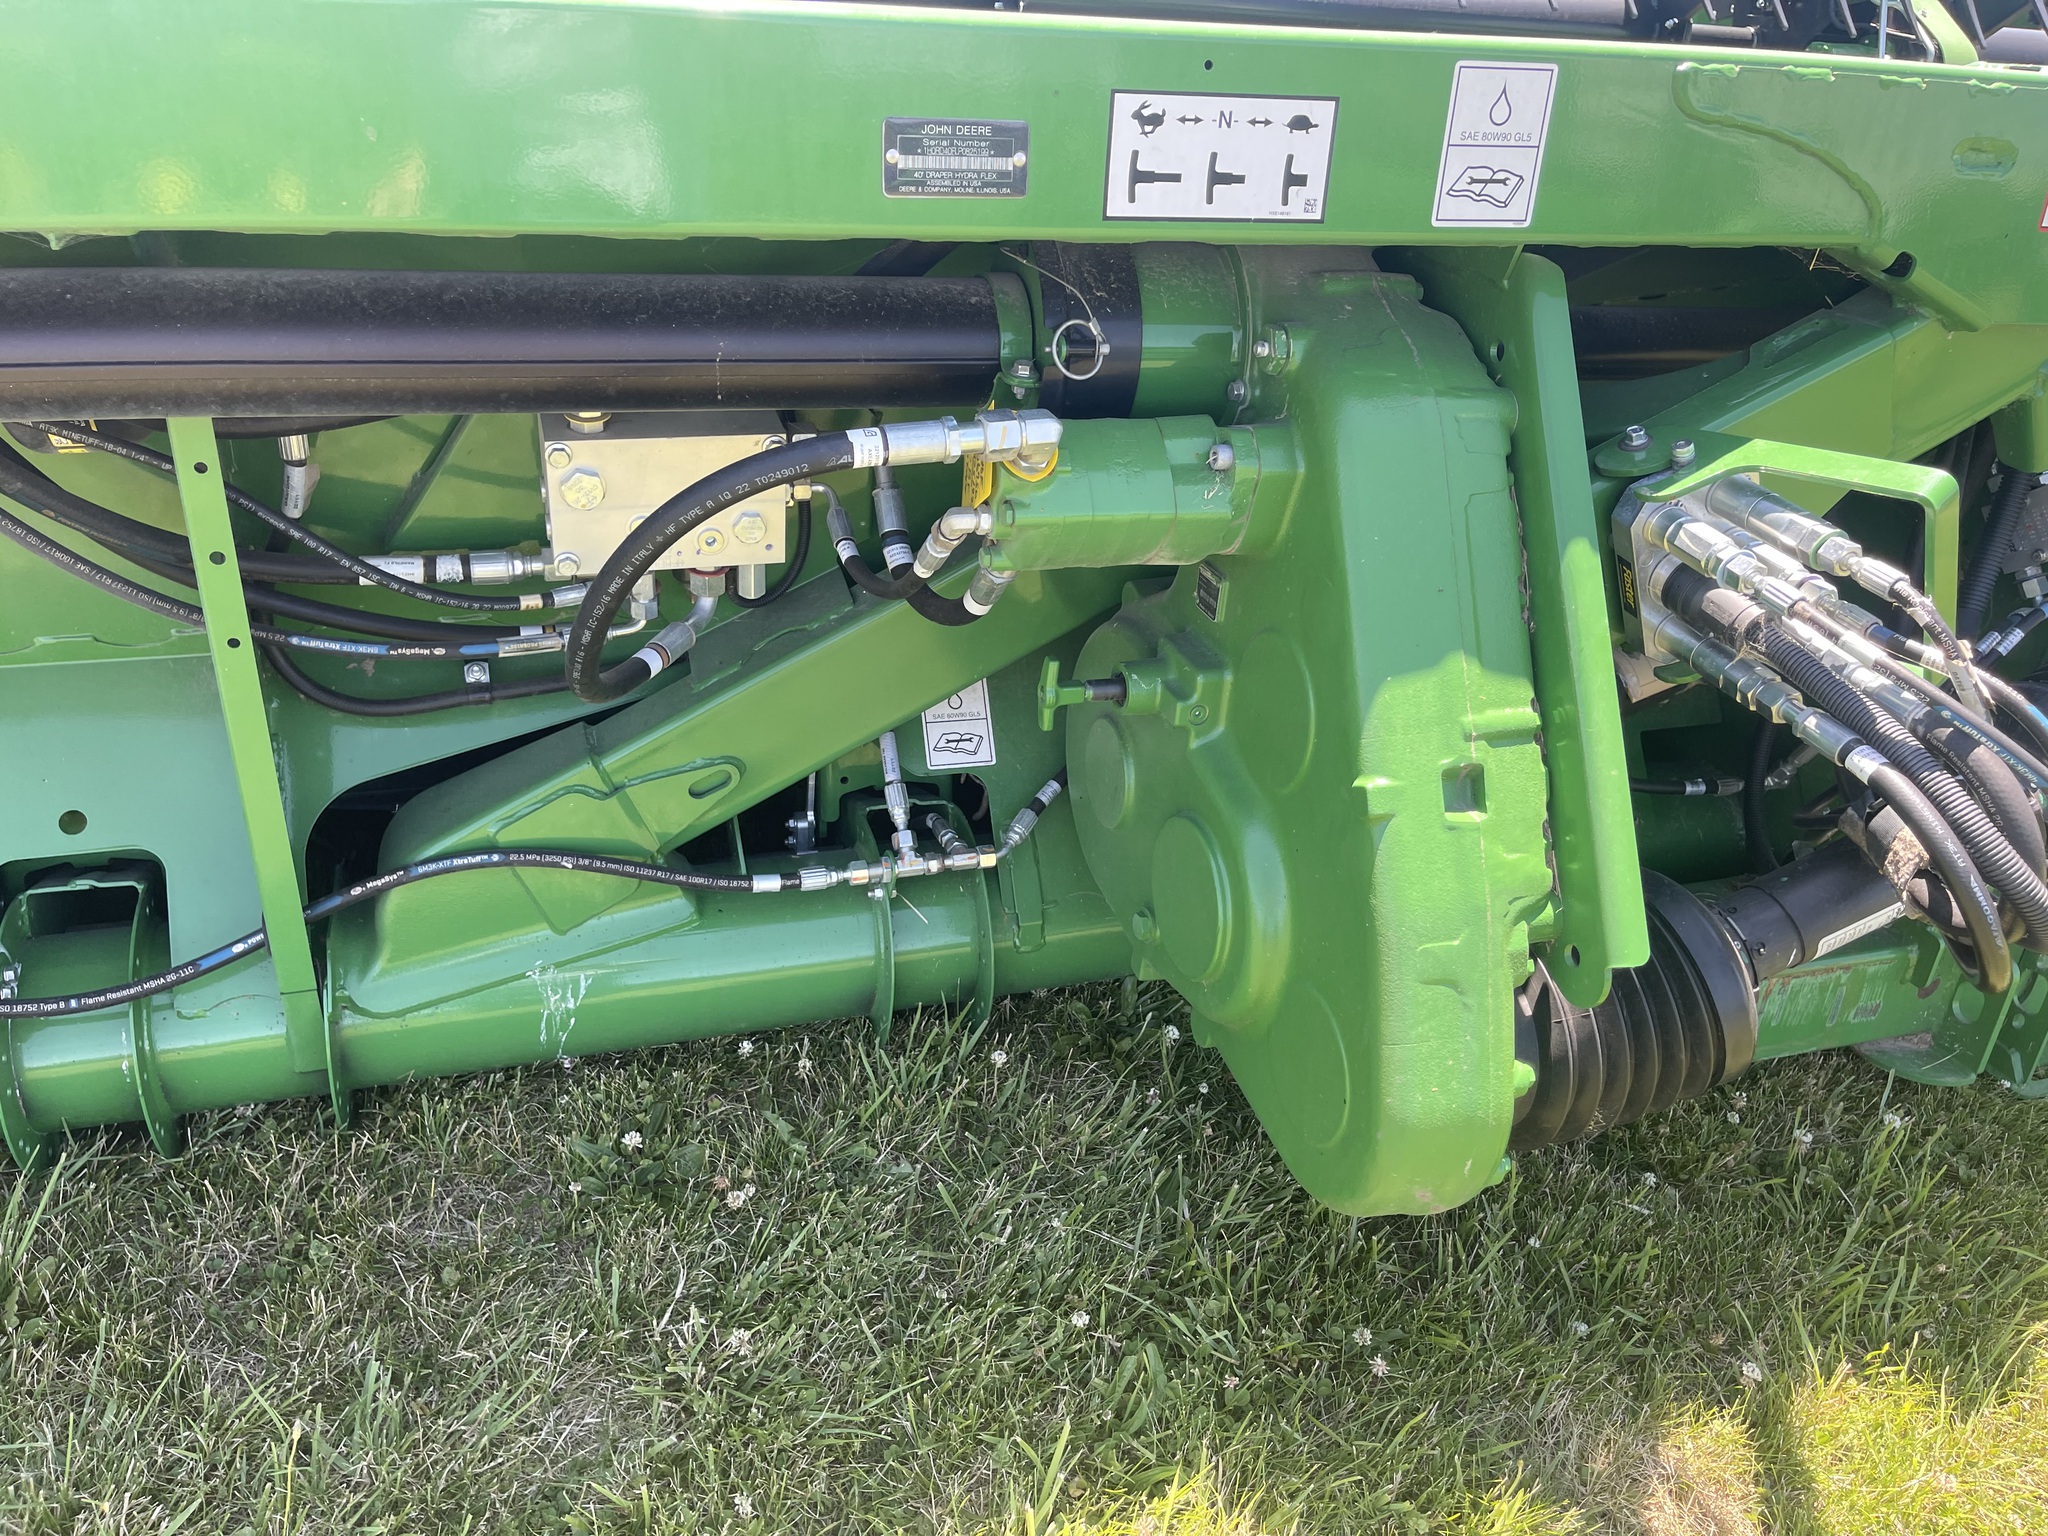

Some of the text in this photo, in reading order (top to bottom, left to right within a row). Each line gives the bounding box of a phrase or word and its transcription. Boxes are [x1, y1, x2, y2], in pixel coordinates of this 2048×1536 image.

[921, 124, 992, 136] JOHN DEERE
[1460, 131, 1532, 142] SAE 80W90 GL5
[922, 138, 990, 147] Serial Number
[925, 171, 952, 179] DRAPER
[39, 423, 59, 435] AT3K
[1, 518, 26, 537] 18752
[26, 532, 41, 547] ISO
[607, 575, 626, 595] MADE
[622, 564, 633, 577] IN
[632, 542, 655, 566] ITALY
[665, 522, 677, 536] HF
[678, 505, 705, 525] TYPE
[706, 500, 715, 509] A
[735, 482, 751, 495] 22
[44, 546, 73, 564] 100R17
[257, 511, 286, 531] exceeds
[287, 528, 303, 541] SAE
[304, 537, 317, 549] 100
[317, 545, 333, 558] R17
[340, 558, 351, 568] EN
[352, 564, 366, 575] 857
[415, 590, 432, 603] MSHA
[74, 561, 92, 575] SAE
[95, 573, 112, 586] R17
[112, 581, 137, 596] 11237
[138, 591, 153, 603] ISO
[268, 632, 285, 642] 22.5
[1938, 632, 1958, 659] MSHA
[946, 711, 966, 719] 80W90
[1925, 733, 1948, 755] Flame
[1948, 751, 1980, 790] Resistant
[1977, 786, 1996, 814] MSHA
[1943, 838, 1966, 868] AT3K
[509, 853, 525, 862] 22.5
[525, 853, 541, 862] MPa
[623, 864, 635, 872] ISO
[635, 865, 656, 877] 11237
[656, 870, 670, 879] R17
[674, 873, 687, 882] SAE
[688, 875, 713, 886] 100R17
[717, 879, 729, 888] ISO
[729, 880, 750, 888] 18752
[781, 878, 800, 887] Flame
[12, 1003, 38, 1013] 18752
[39, 1002, 58, 1013] Type
[59, 1001, 66, 1010] B
[80, 996, 105, 1006] Flame
[106, 986, 142, 1001] Resistant
[142, 977, 166, 991] MSHA
